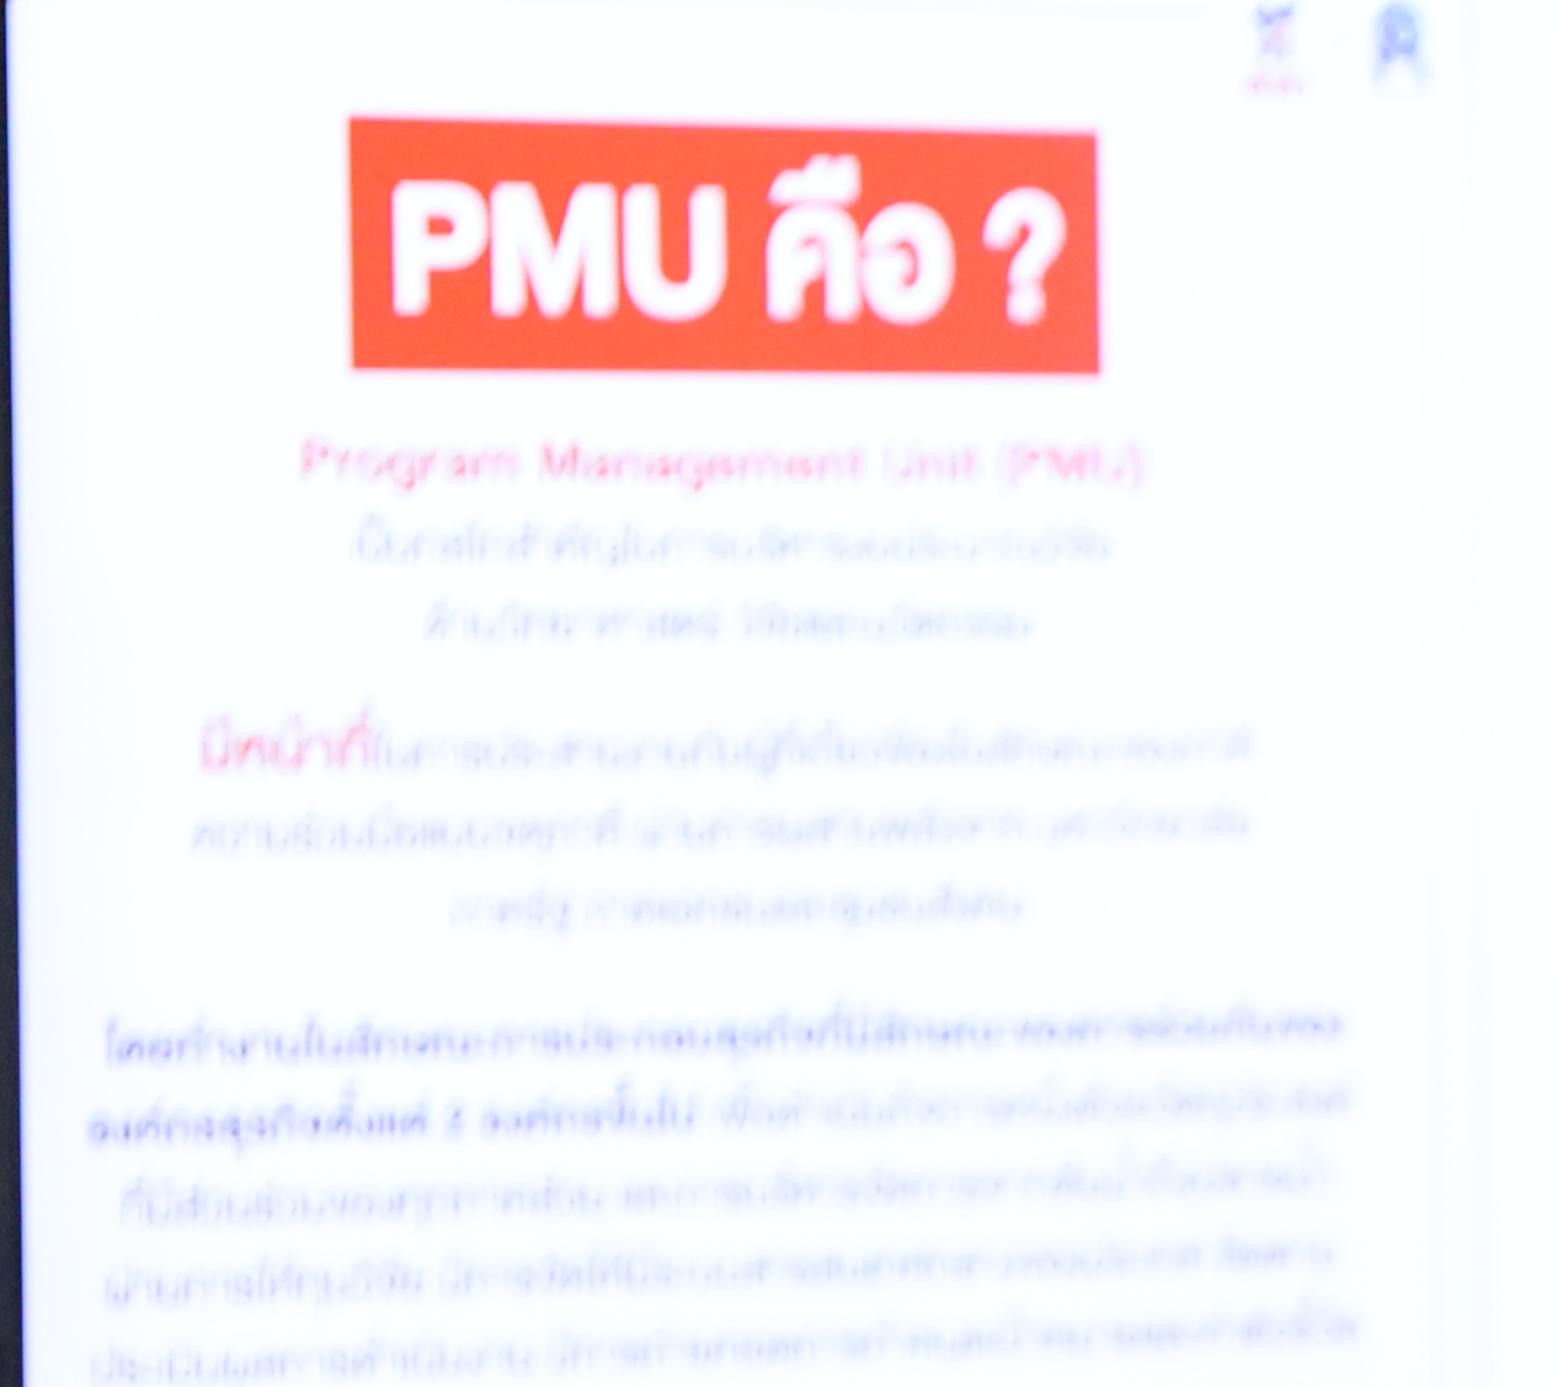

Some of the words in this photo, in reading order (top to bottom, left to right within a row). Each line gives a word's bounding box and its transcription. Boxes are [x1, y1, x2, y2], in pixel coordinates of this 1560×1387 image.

[392, 180, 728, 323] PMU
[764, 154, 956, 326] คือ
[983, 187, 1068, 327] ?
[299, 436, 520, 492] Program
[539, 440, 862, 493] Management
